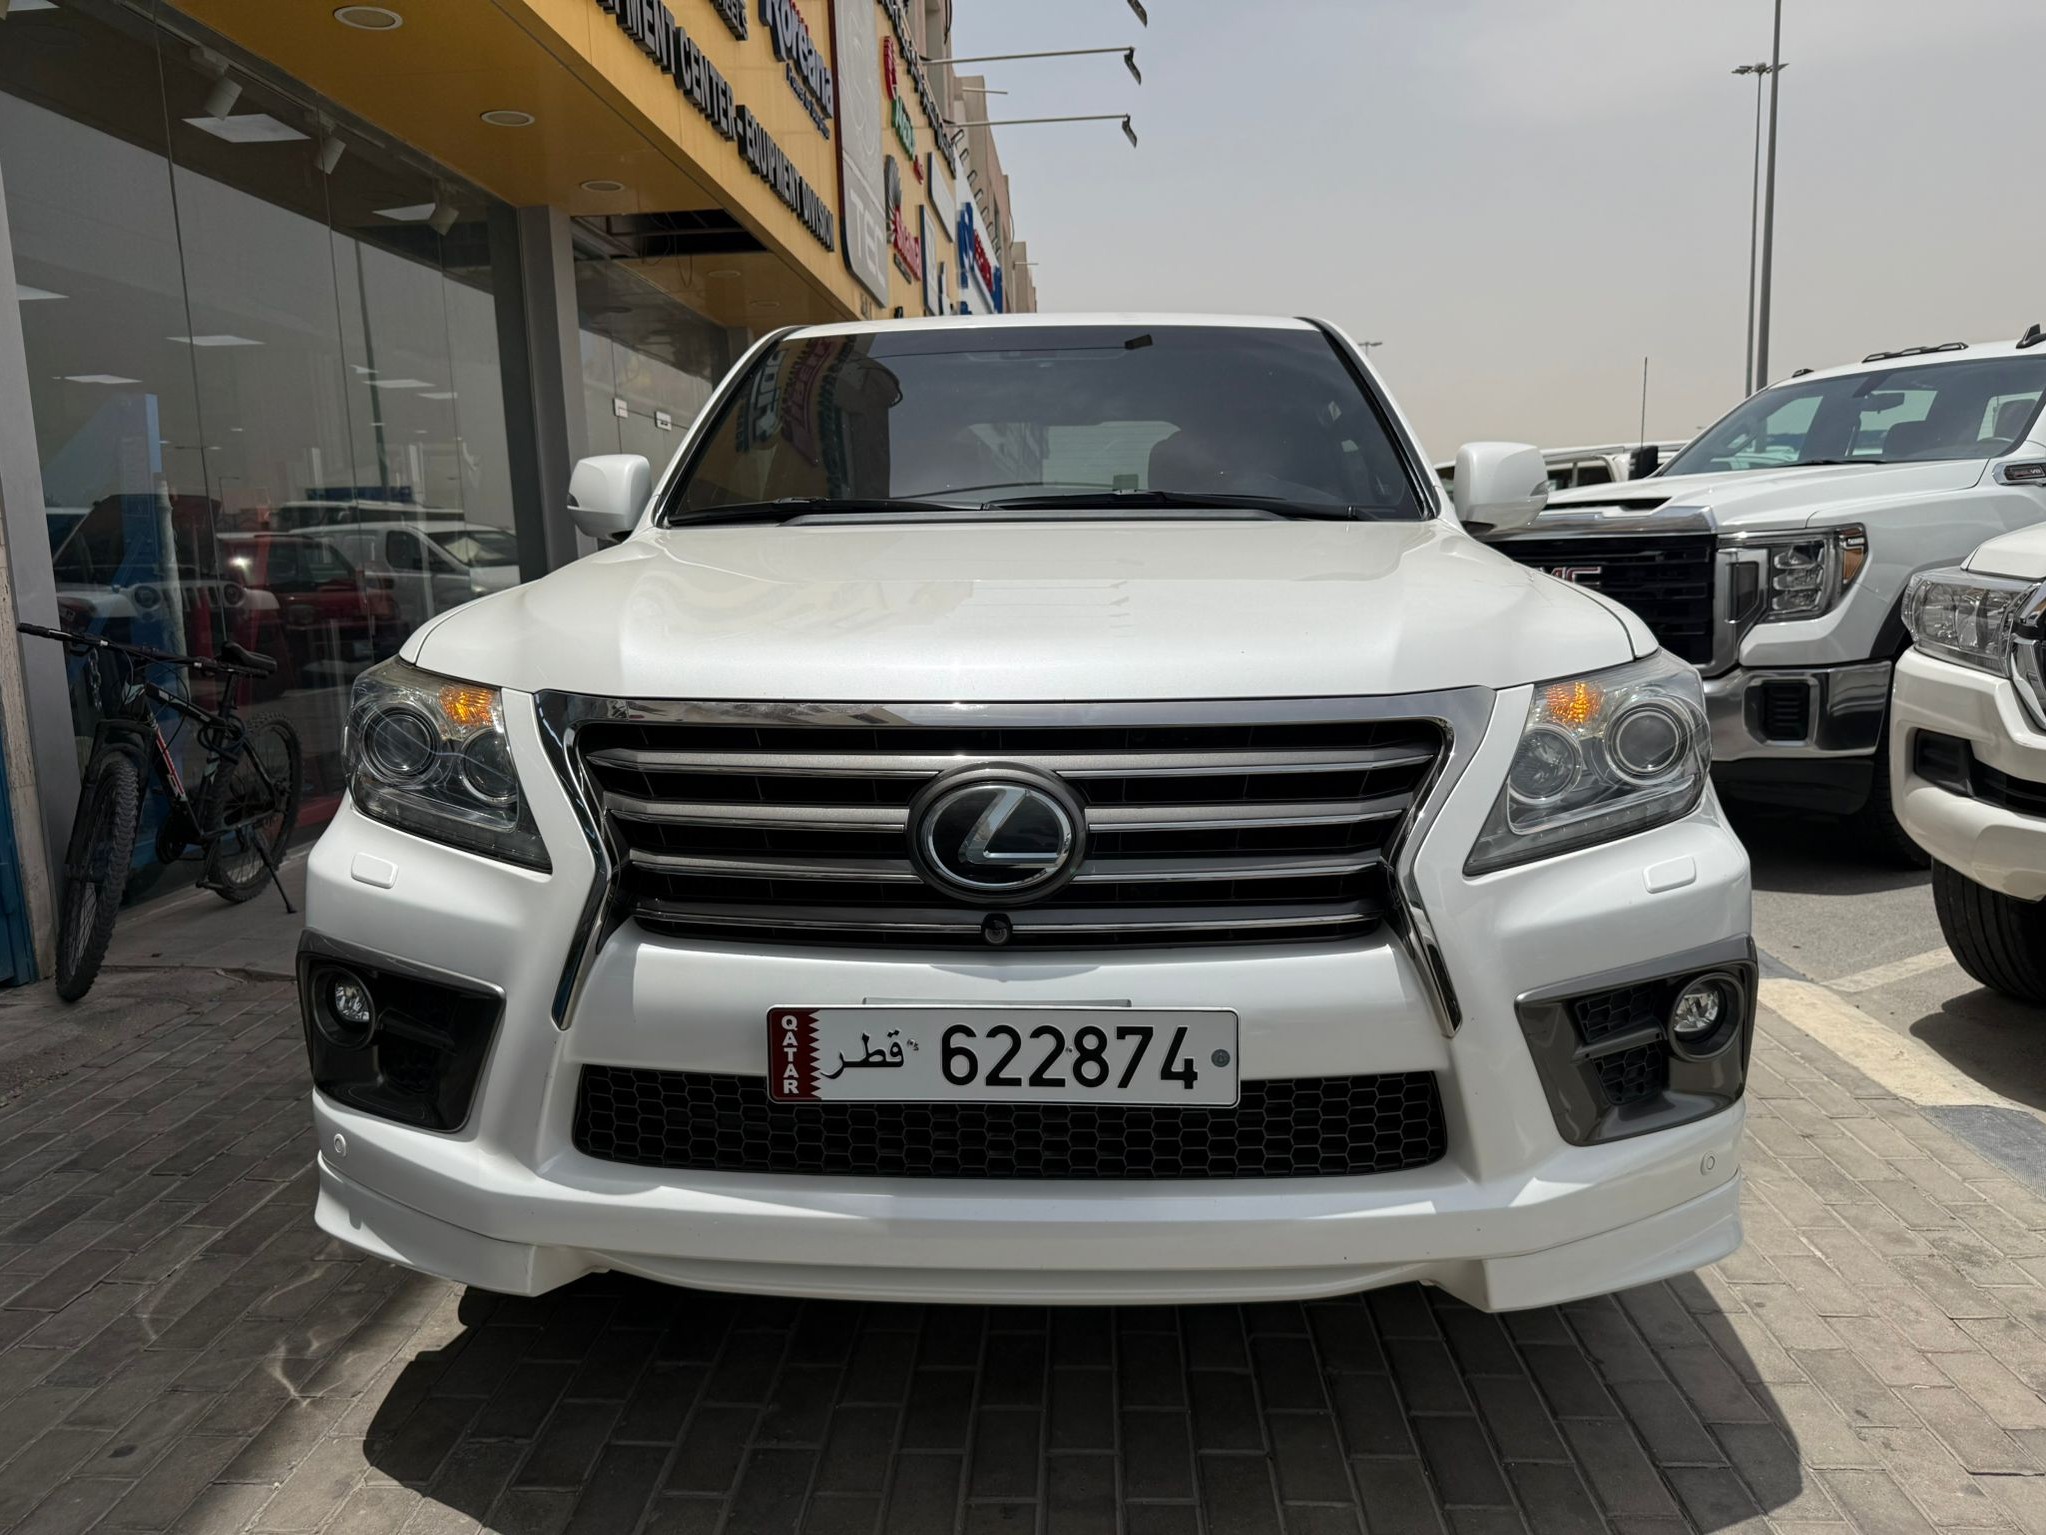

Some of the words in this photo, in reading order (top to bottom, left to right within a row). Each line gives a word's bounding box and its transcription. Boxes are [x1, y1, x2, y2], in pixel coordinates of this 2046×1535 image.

[679, 27, 735, 141] CENTER
[744, 106, 800, 214] EQUIPMENT
[800, 176, 834, 252] DIVISION
[780, 1014, 800, 1095] QATAR
[819, 1029, 904, 1080] قطر
[941, 1023, 1198, 1090] 622874
